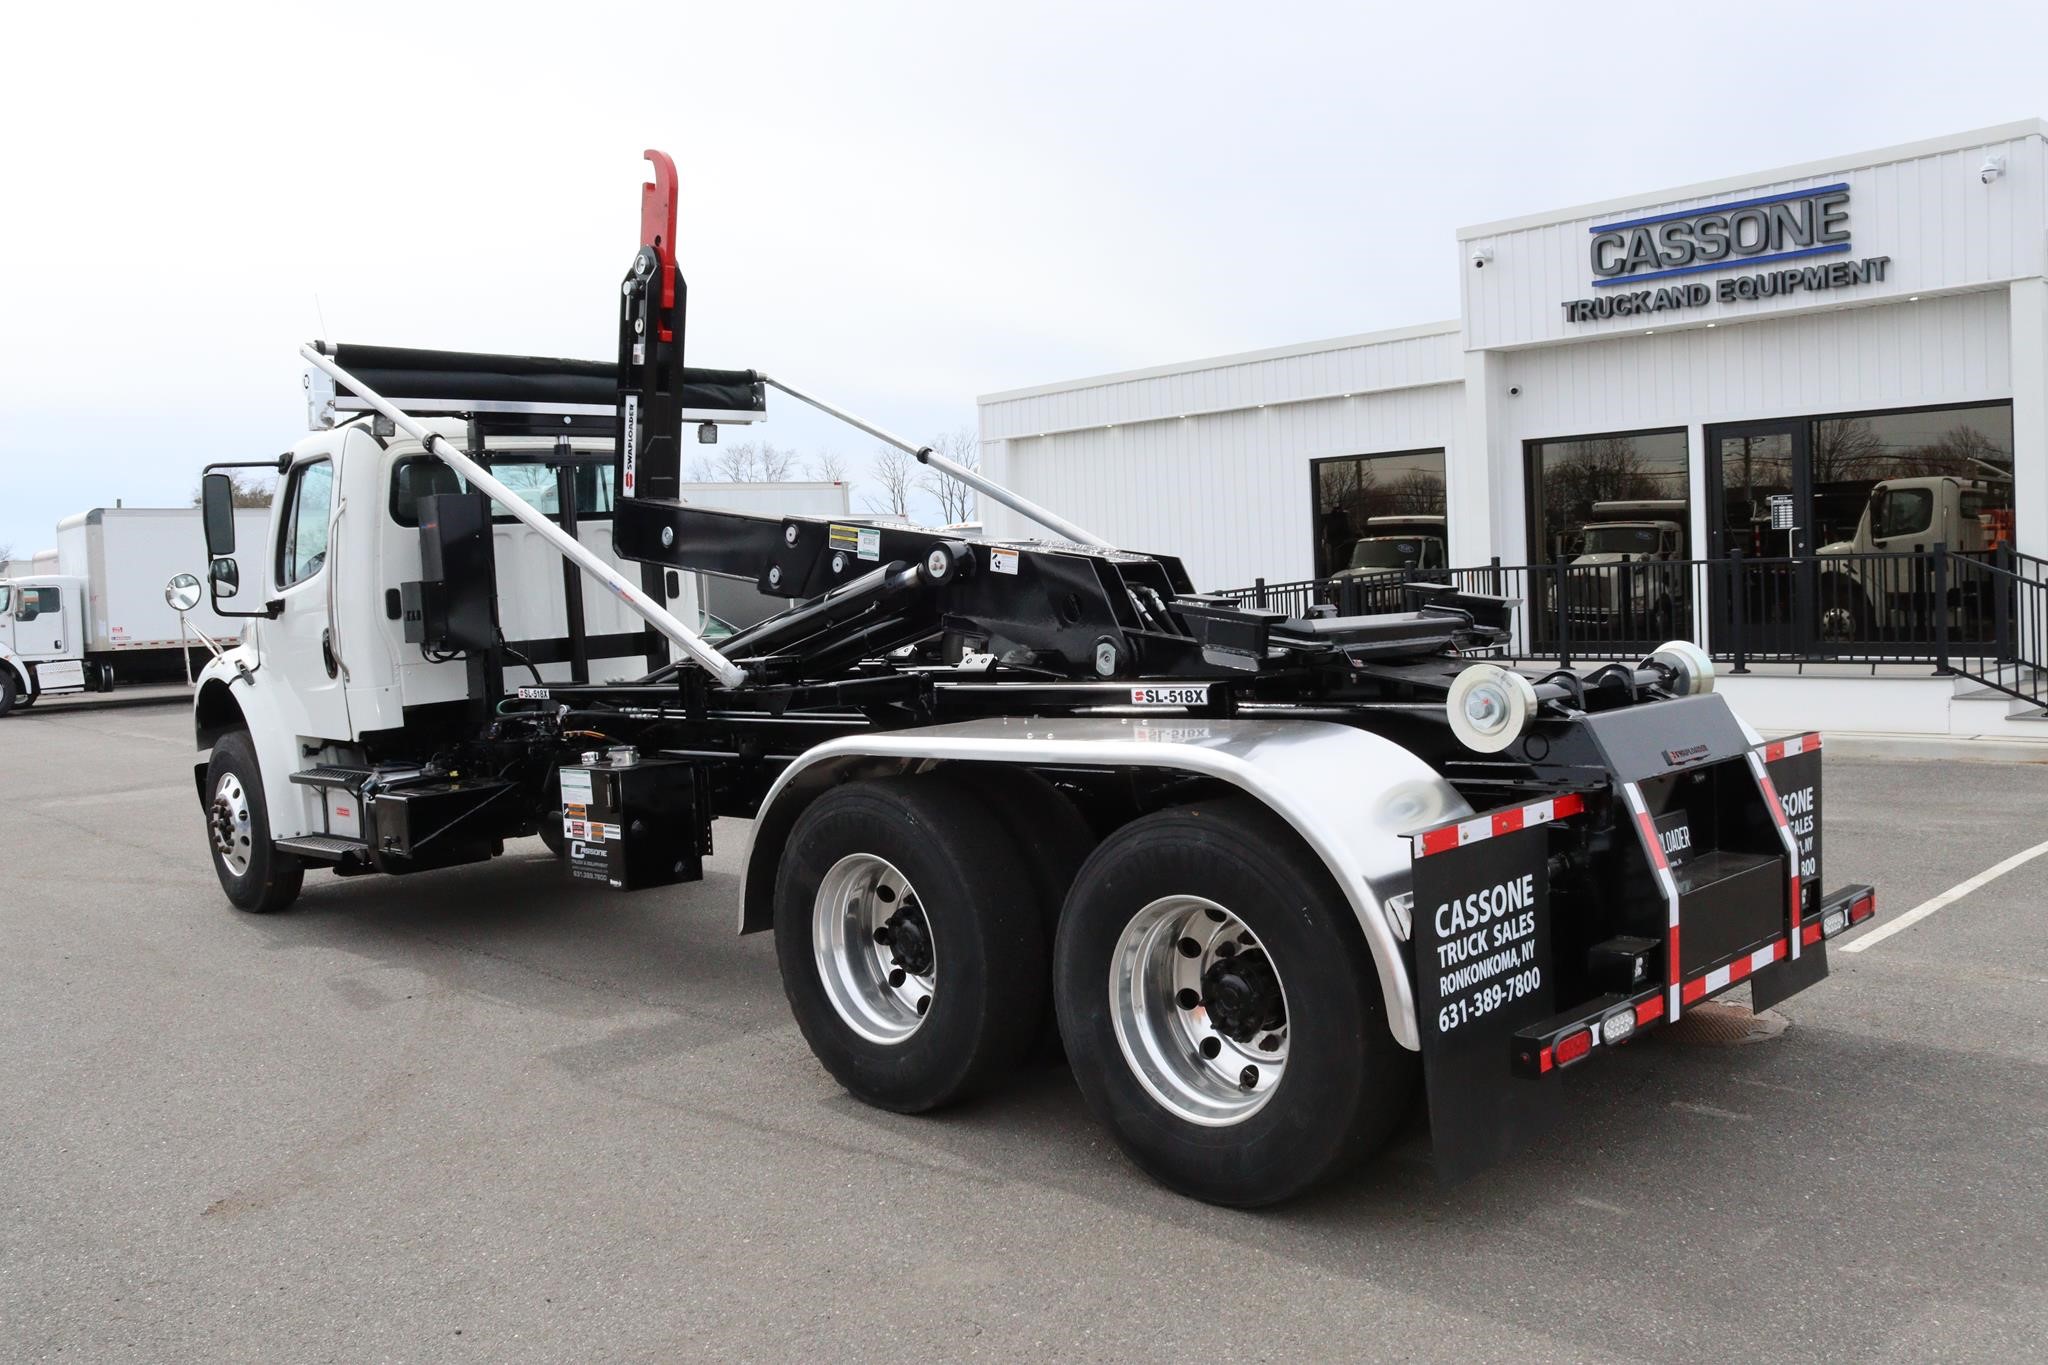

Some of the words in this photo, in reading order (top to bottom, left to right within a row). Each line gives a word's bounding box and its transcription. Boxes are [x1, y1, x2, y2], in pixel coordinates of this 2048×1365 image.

[1590, 193, 1850, 277] CASSONE
[1562, 290, 1654, 323] TRUCK
[1652, 282, 1711, 312] AND
[1716, 255, 1891, 303] EQUIPMENT
[524, 689, 549, 698] SL-518X
[1145, 689, 1204, 703] SL-518X
[571, 840, 608, 859] CASSONE
[1435, 874, 1535, 938] CASSONE
[1437, 929, 1489, 969] TRUCK
[1493, 911, 1535, 947] SALES
[1440, 950, 1521, 997] RONKONKOMA,
[1521, 939, 1535, 961] NY
[1438, 966, 1541, 1032] 631-389-7800
